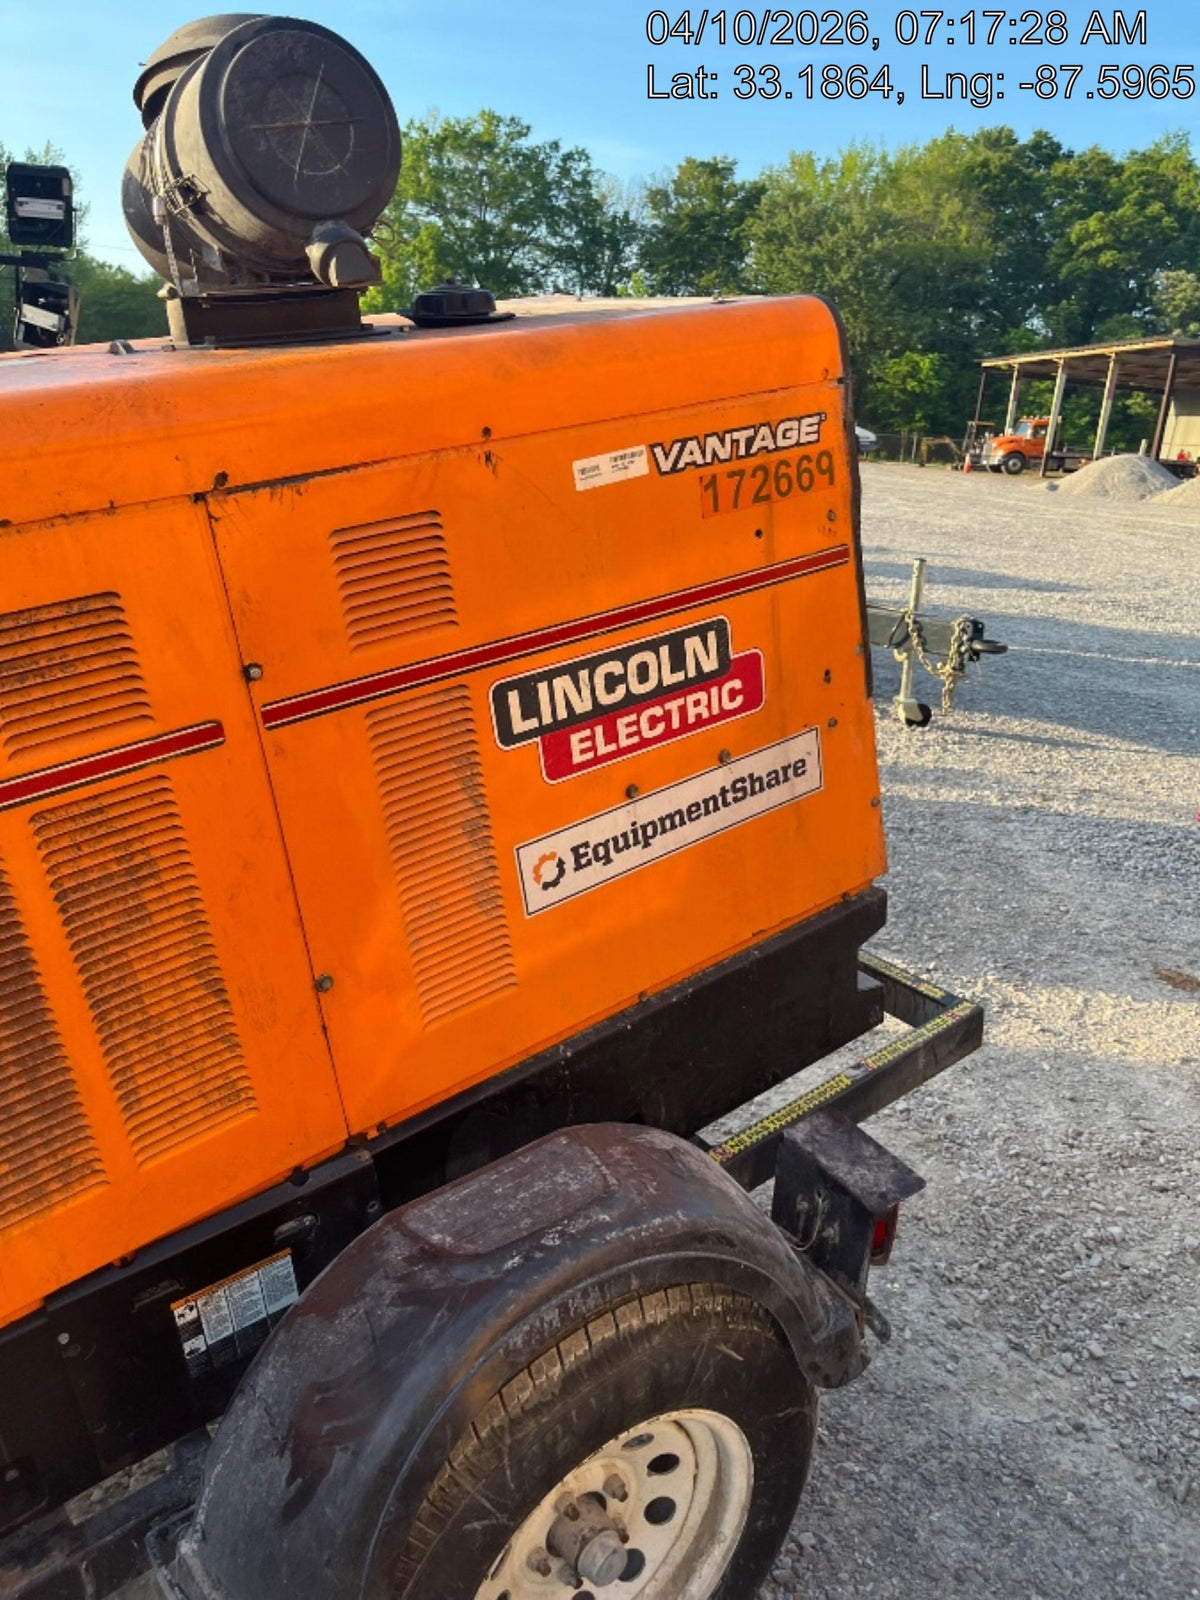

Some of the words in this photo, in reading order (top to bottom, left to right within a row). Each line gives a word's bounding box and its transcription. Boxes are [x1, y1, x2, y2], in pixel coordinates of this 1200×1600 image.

[652, 414, 821, 475] VANTAGE
[703, 450, 836, 513] 172669
[507, 630, 719, 736] LINCOLN
[570, 680, 744, 765] ELECTRIC
[570, 756, 808, 874] EquipmentShare
